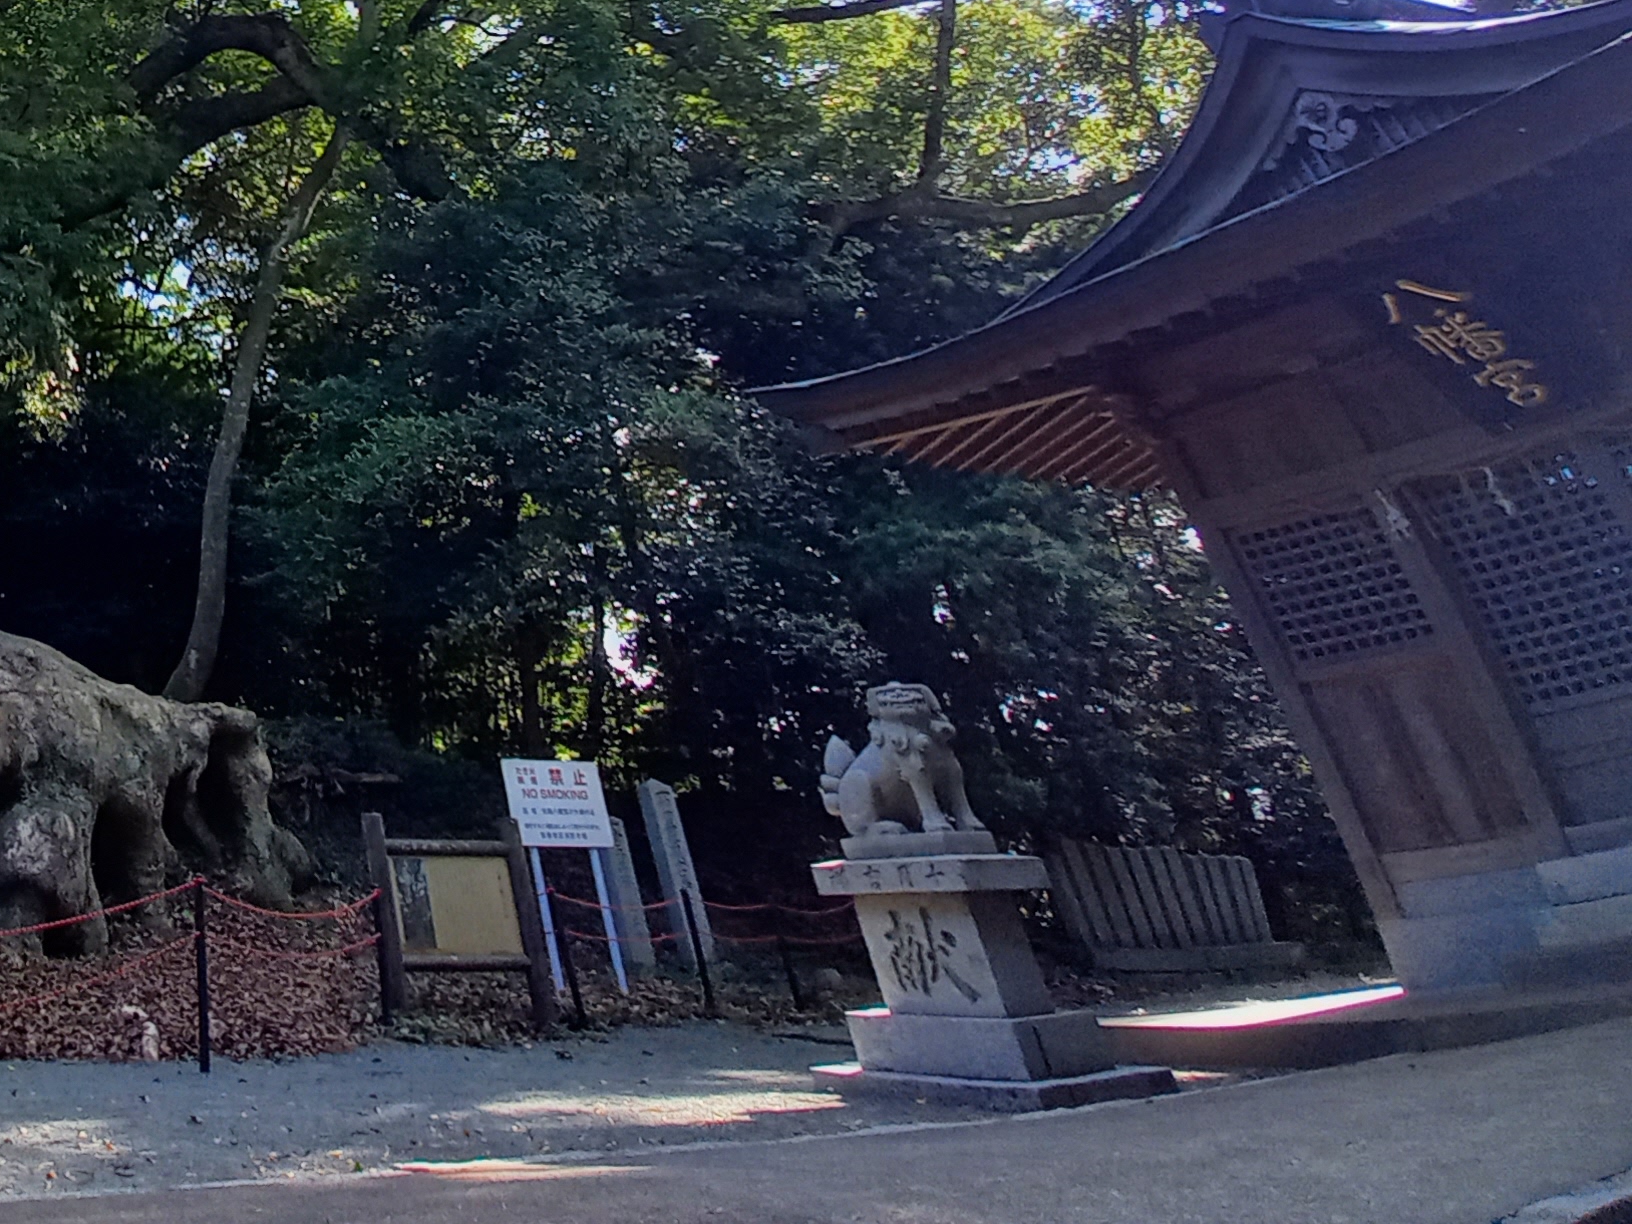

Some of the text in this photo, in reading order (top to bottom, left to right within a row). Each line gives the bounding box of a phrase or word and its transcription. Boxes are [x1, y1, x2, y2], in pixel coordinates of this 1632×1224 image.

[548, 767, 587, 786] 禁止
[521, 788, 589, 800] NO SMOKING
